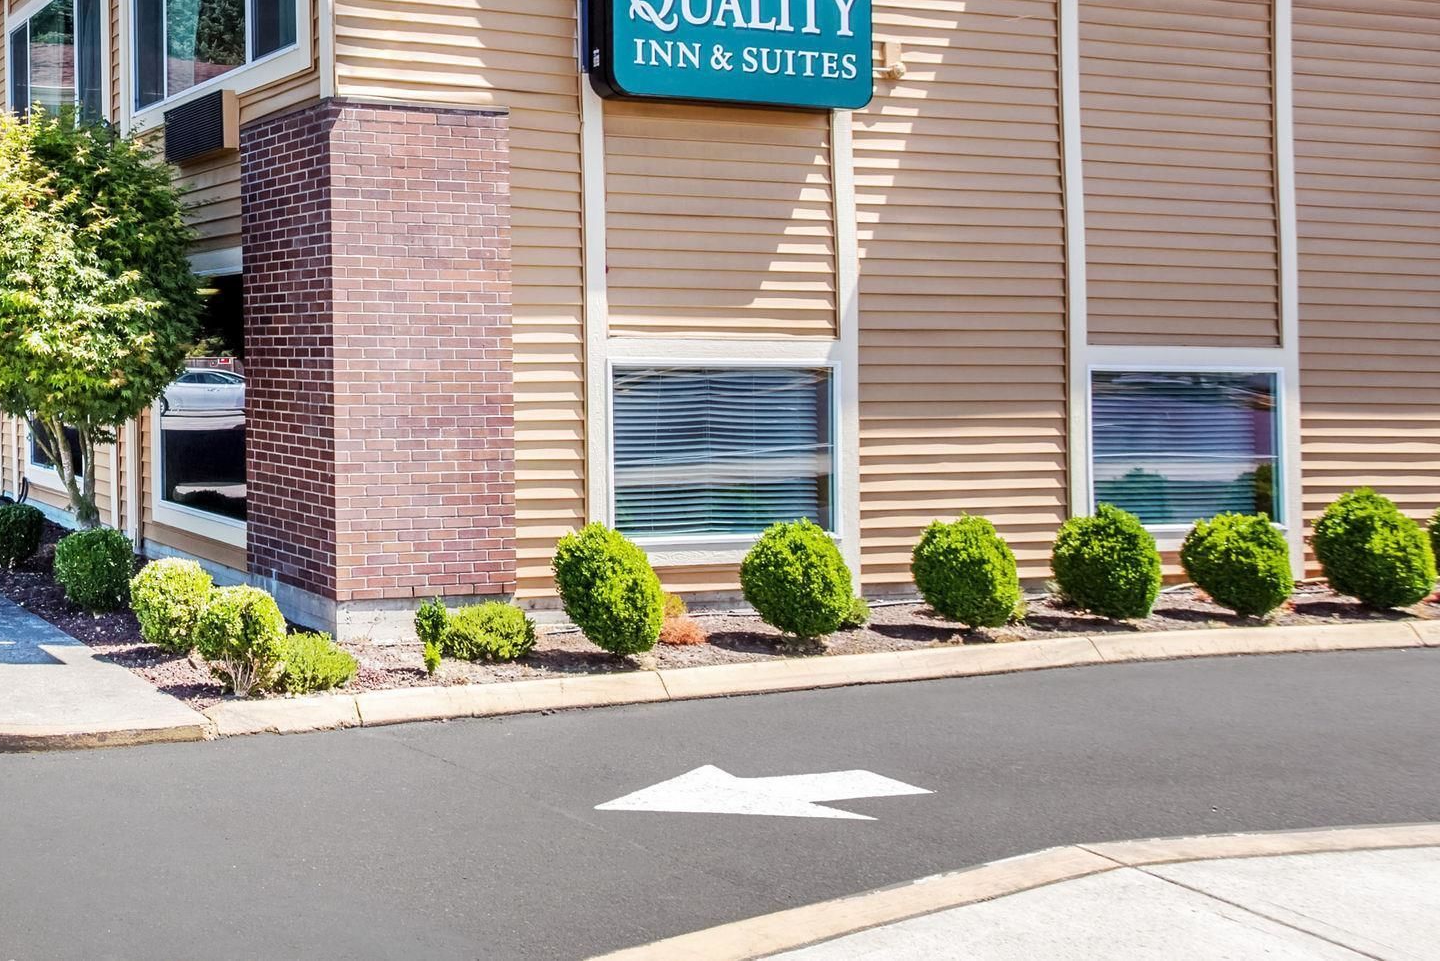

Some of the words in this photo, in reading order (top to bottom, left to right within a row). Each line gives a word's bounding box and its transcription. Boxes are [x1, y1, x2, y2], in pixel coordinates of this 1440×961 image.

[633, 38, 702, 69] INN
[710, 44, 734, 72] &
[741, 47, 858, 80] SUITES
